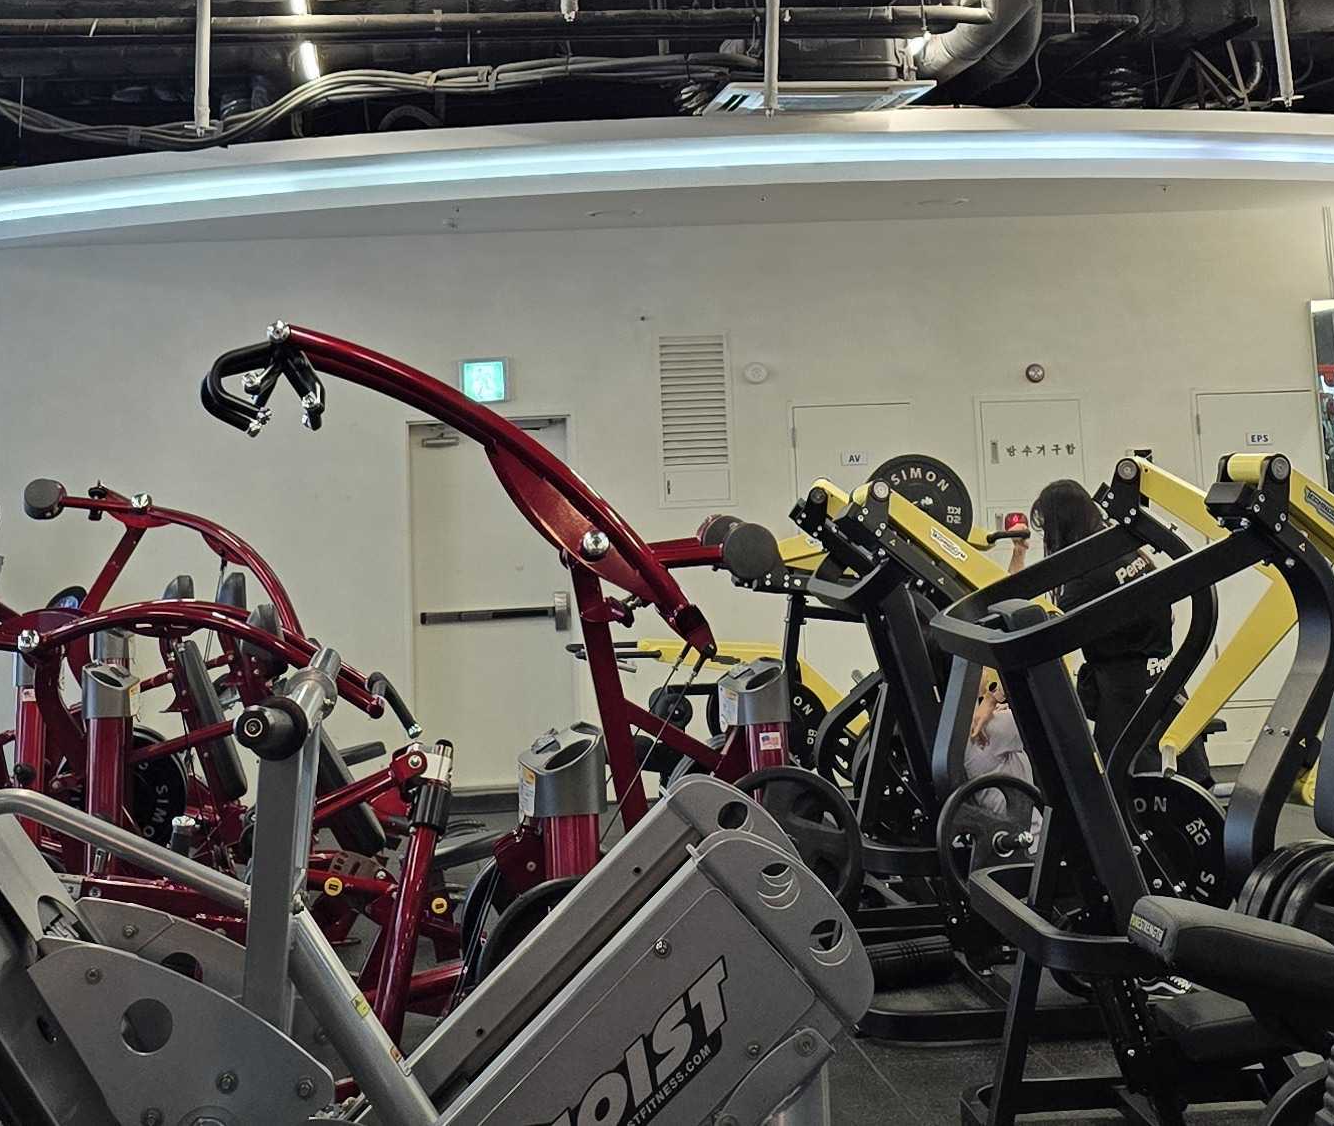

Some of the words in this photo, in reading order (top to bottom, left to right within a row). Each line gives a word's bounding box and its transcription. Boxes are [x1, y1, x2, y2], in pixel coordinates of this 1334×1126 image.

[1250, 434, 1269, 442] EPS
[848, 454, 861, 463] AV
[890, 467, 950, 492] SIMON
